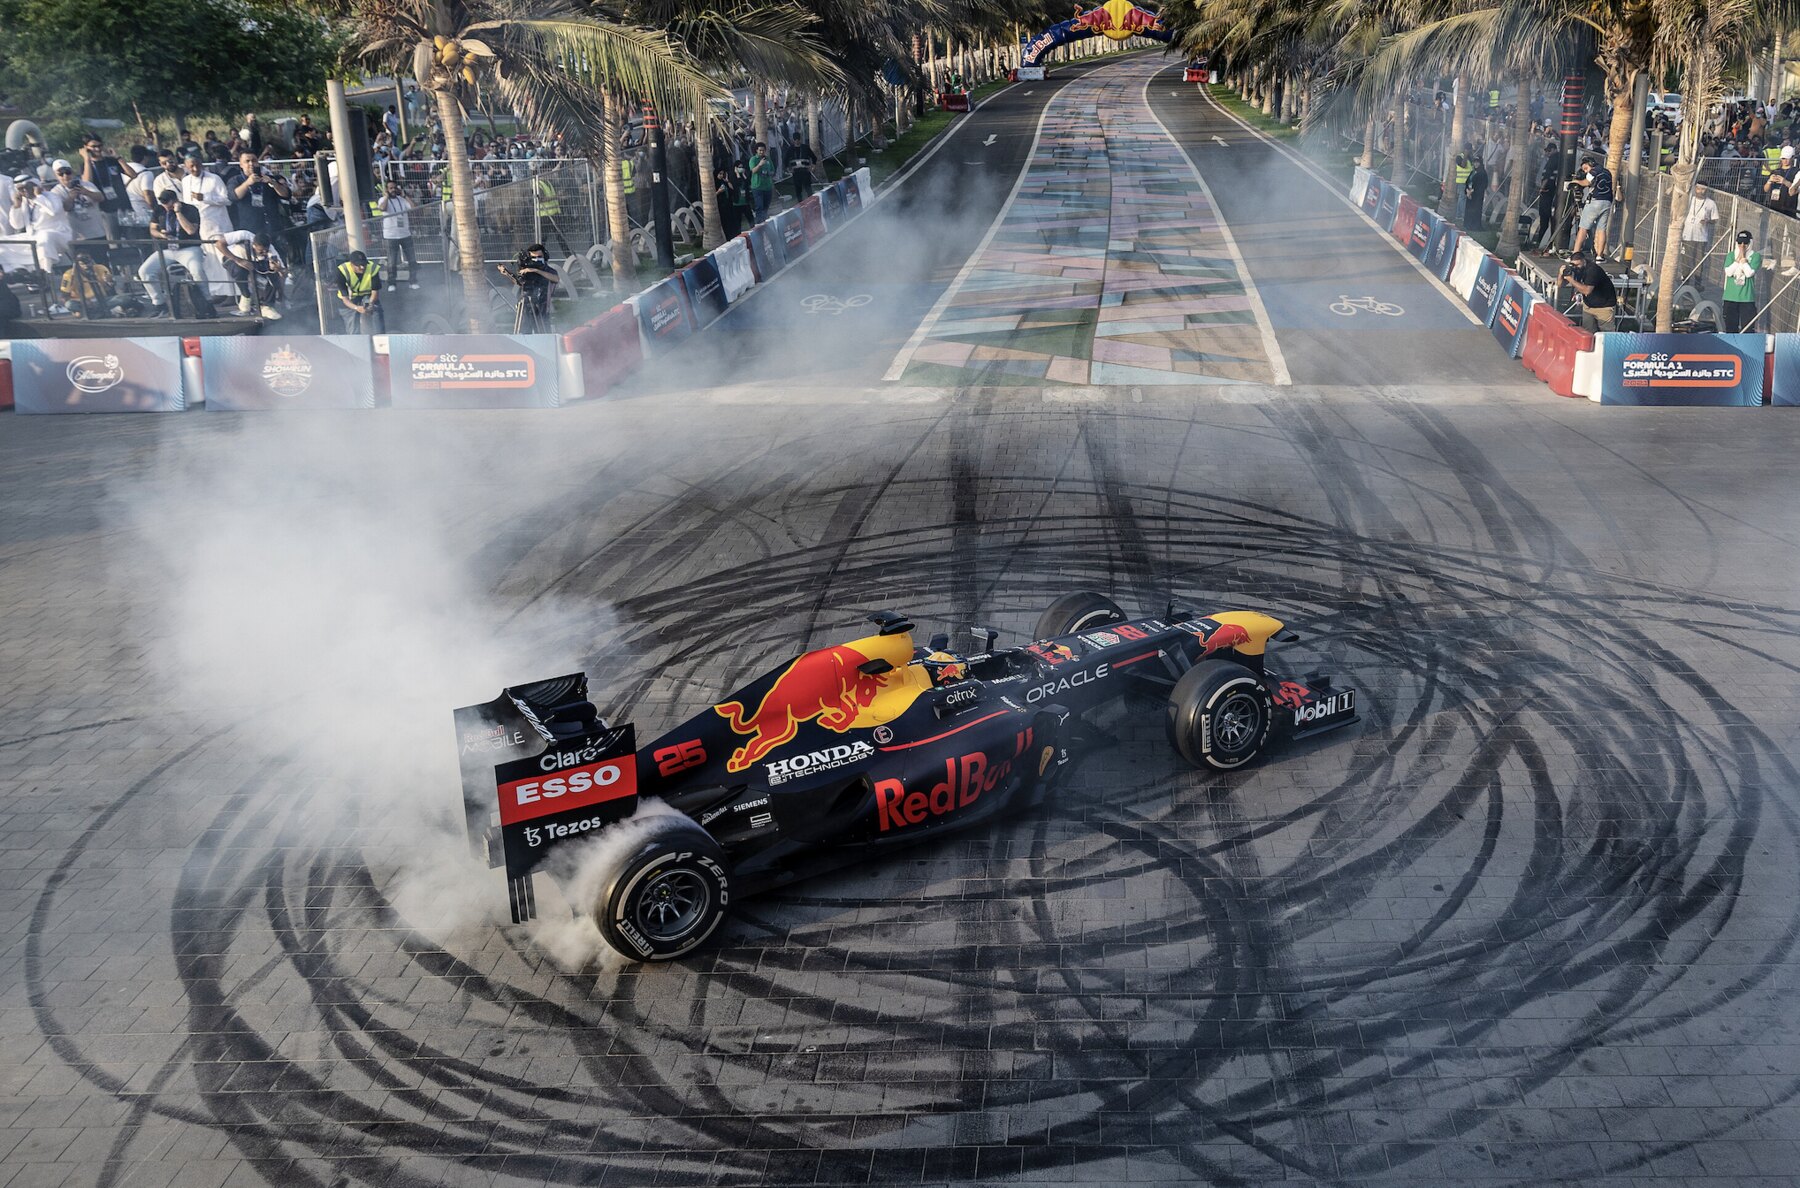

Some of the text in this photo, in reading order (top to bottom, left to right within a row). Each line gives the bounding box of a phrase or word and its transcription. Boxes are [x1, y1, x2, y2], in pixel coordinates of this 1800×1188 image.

[412, 363, 466, 371] FORMULA
[1623, 361, 1683, 369] FORMULA 1
[1712, 369, 1734, 377] STC
[946, 686, 977, 704] citrix
[1026, 662, 1109, 704] ORACLE
[1295, 696, 1336, 726] Mobil
[462, 731, 526, 756] MOBILE
[653, 738, 707, 777] 25
[766, 740, 874, 777] HONDA
[516, 765, 621, 806] ESSO
[875, 727, 1034, 831] Red Bull
[733, 797, 768, 813] SIEMENS
[545, 817, 601, 839] Tezos
[675, 852, 729, 906] P ZERO
[616, 919, 655, 957] PIRELLI
